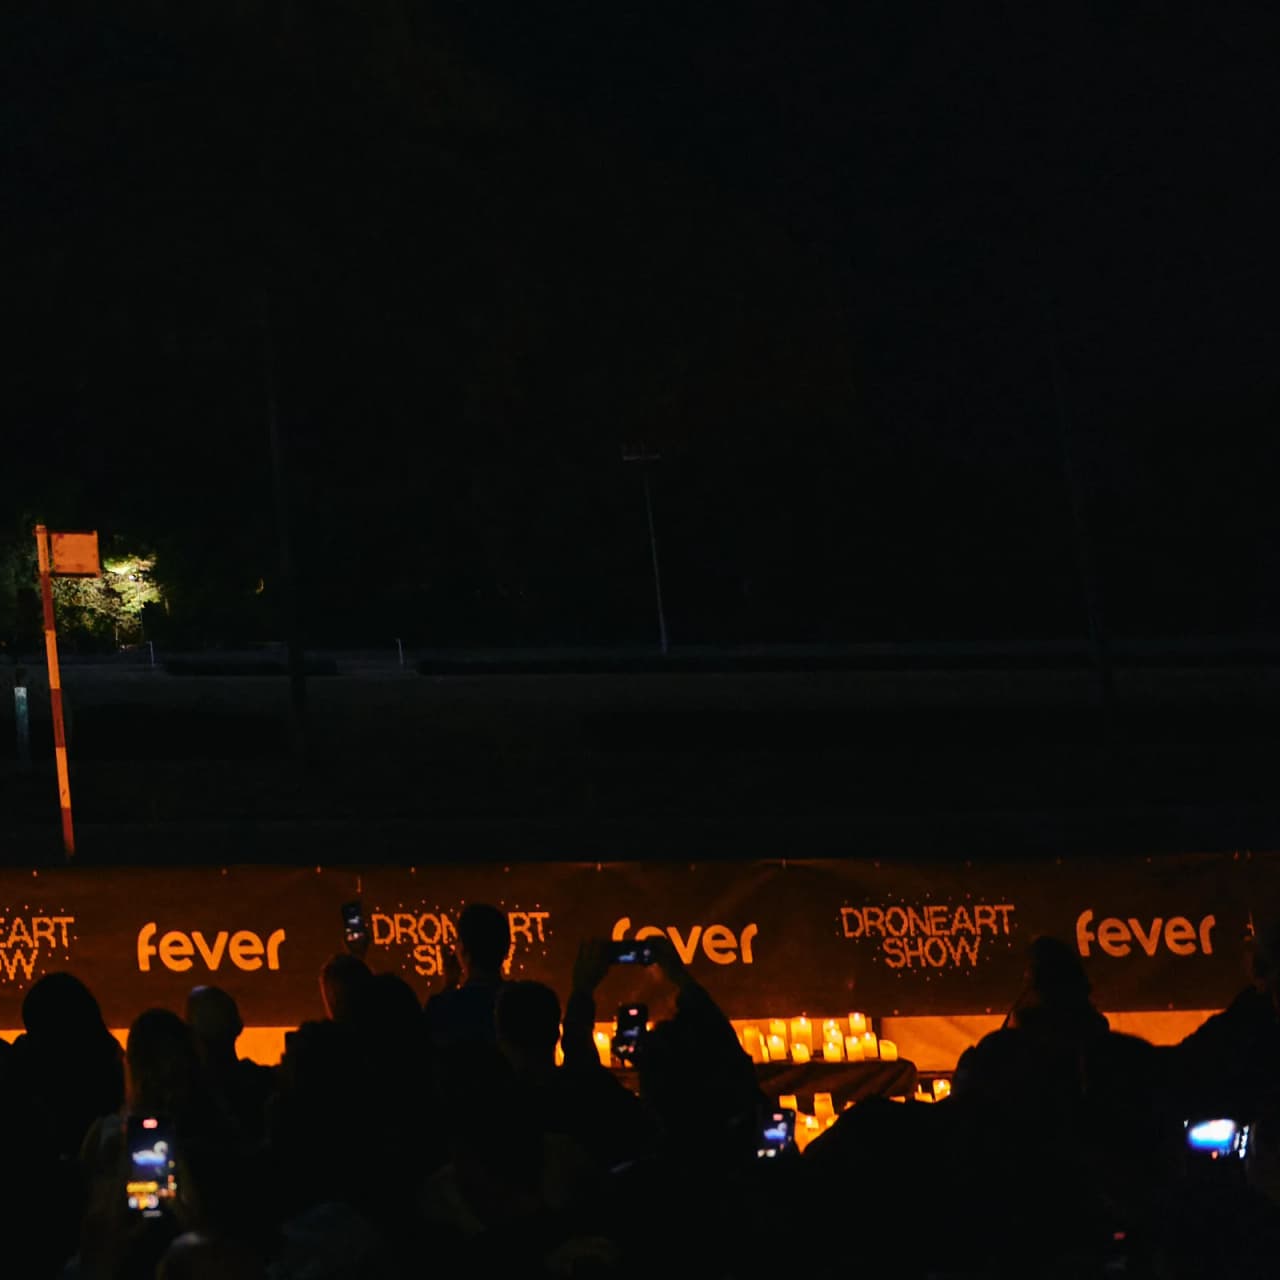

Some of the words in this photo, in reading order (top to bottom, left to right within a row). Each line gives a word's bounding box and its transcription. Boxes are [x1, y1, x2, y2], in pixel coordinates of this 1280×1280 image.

[371, 911, 550, 945] DRONRT
[840, 904, 1015, 938] DRONEART
[1075, 909, 1216, 958] fever
[137, 922, 286, 973] fever
[881, 935, 981, 969] SHOW
